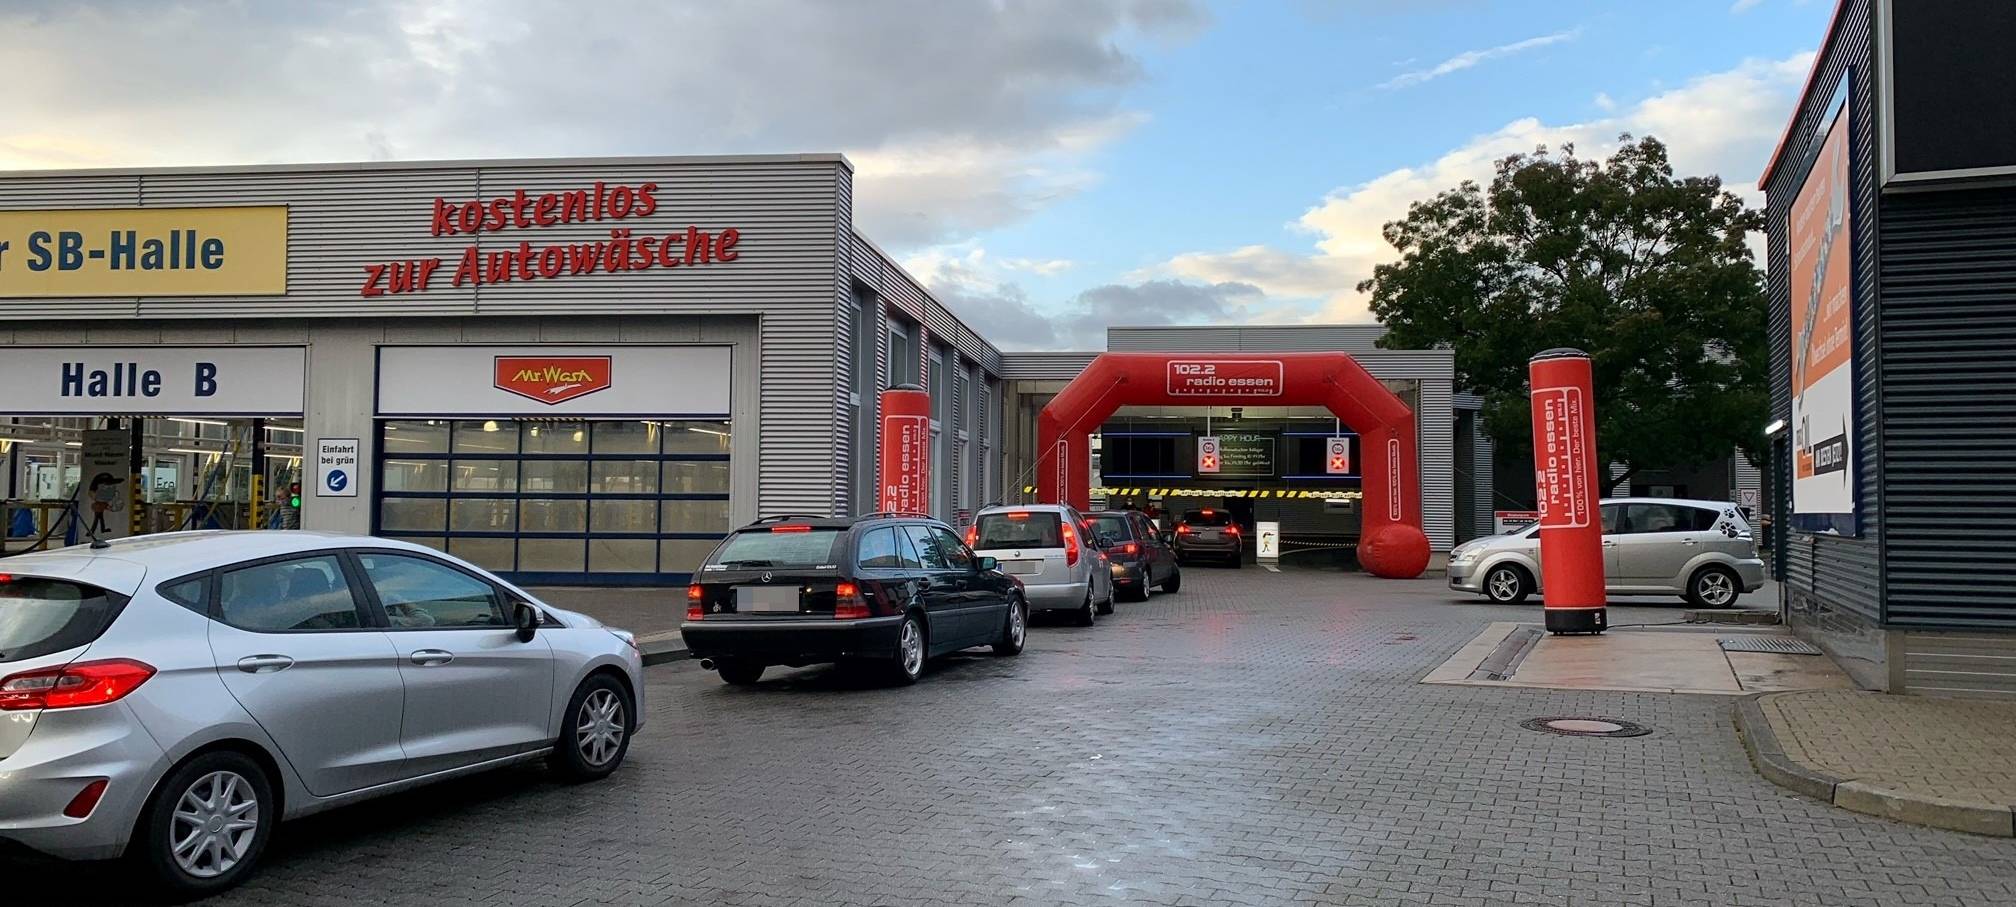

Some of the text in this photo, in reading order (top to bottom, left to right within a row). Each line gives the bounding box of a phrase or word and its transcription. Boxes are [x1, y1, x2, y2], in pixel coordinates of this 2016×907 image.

[431, 181, 657, 237] kostenlos
[27, 229, 225, 272] SB-Halle
[361, 225, 740, 297] zur Autowäsche
[61, 362, 217, 397] Halle B
[1174, 364, 1215, 375] 102.2
[1186, 376, 1273, 386] radio essen
[1571, 416, 1579, 438] beste
[321, 456, 354, 465] bei grün
[322, 445, 354, 453] Einfahrt
[902, 425, 910, 472] essen
[1545, 399, 1559, 504] radio essen
[1537, 470, 1548, 520] 102.2
